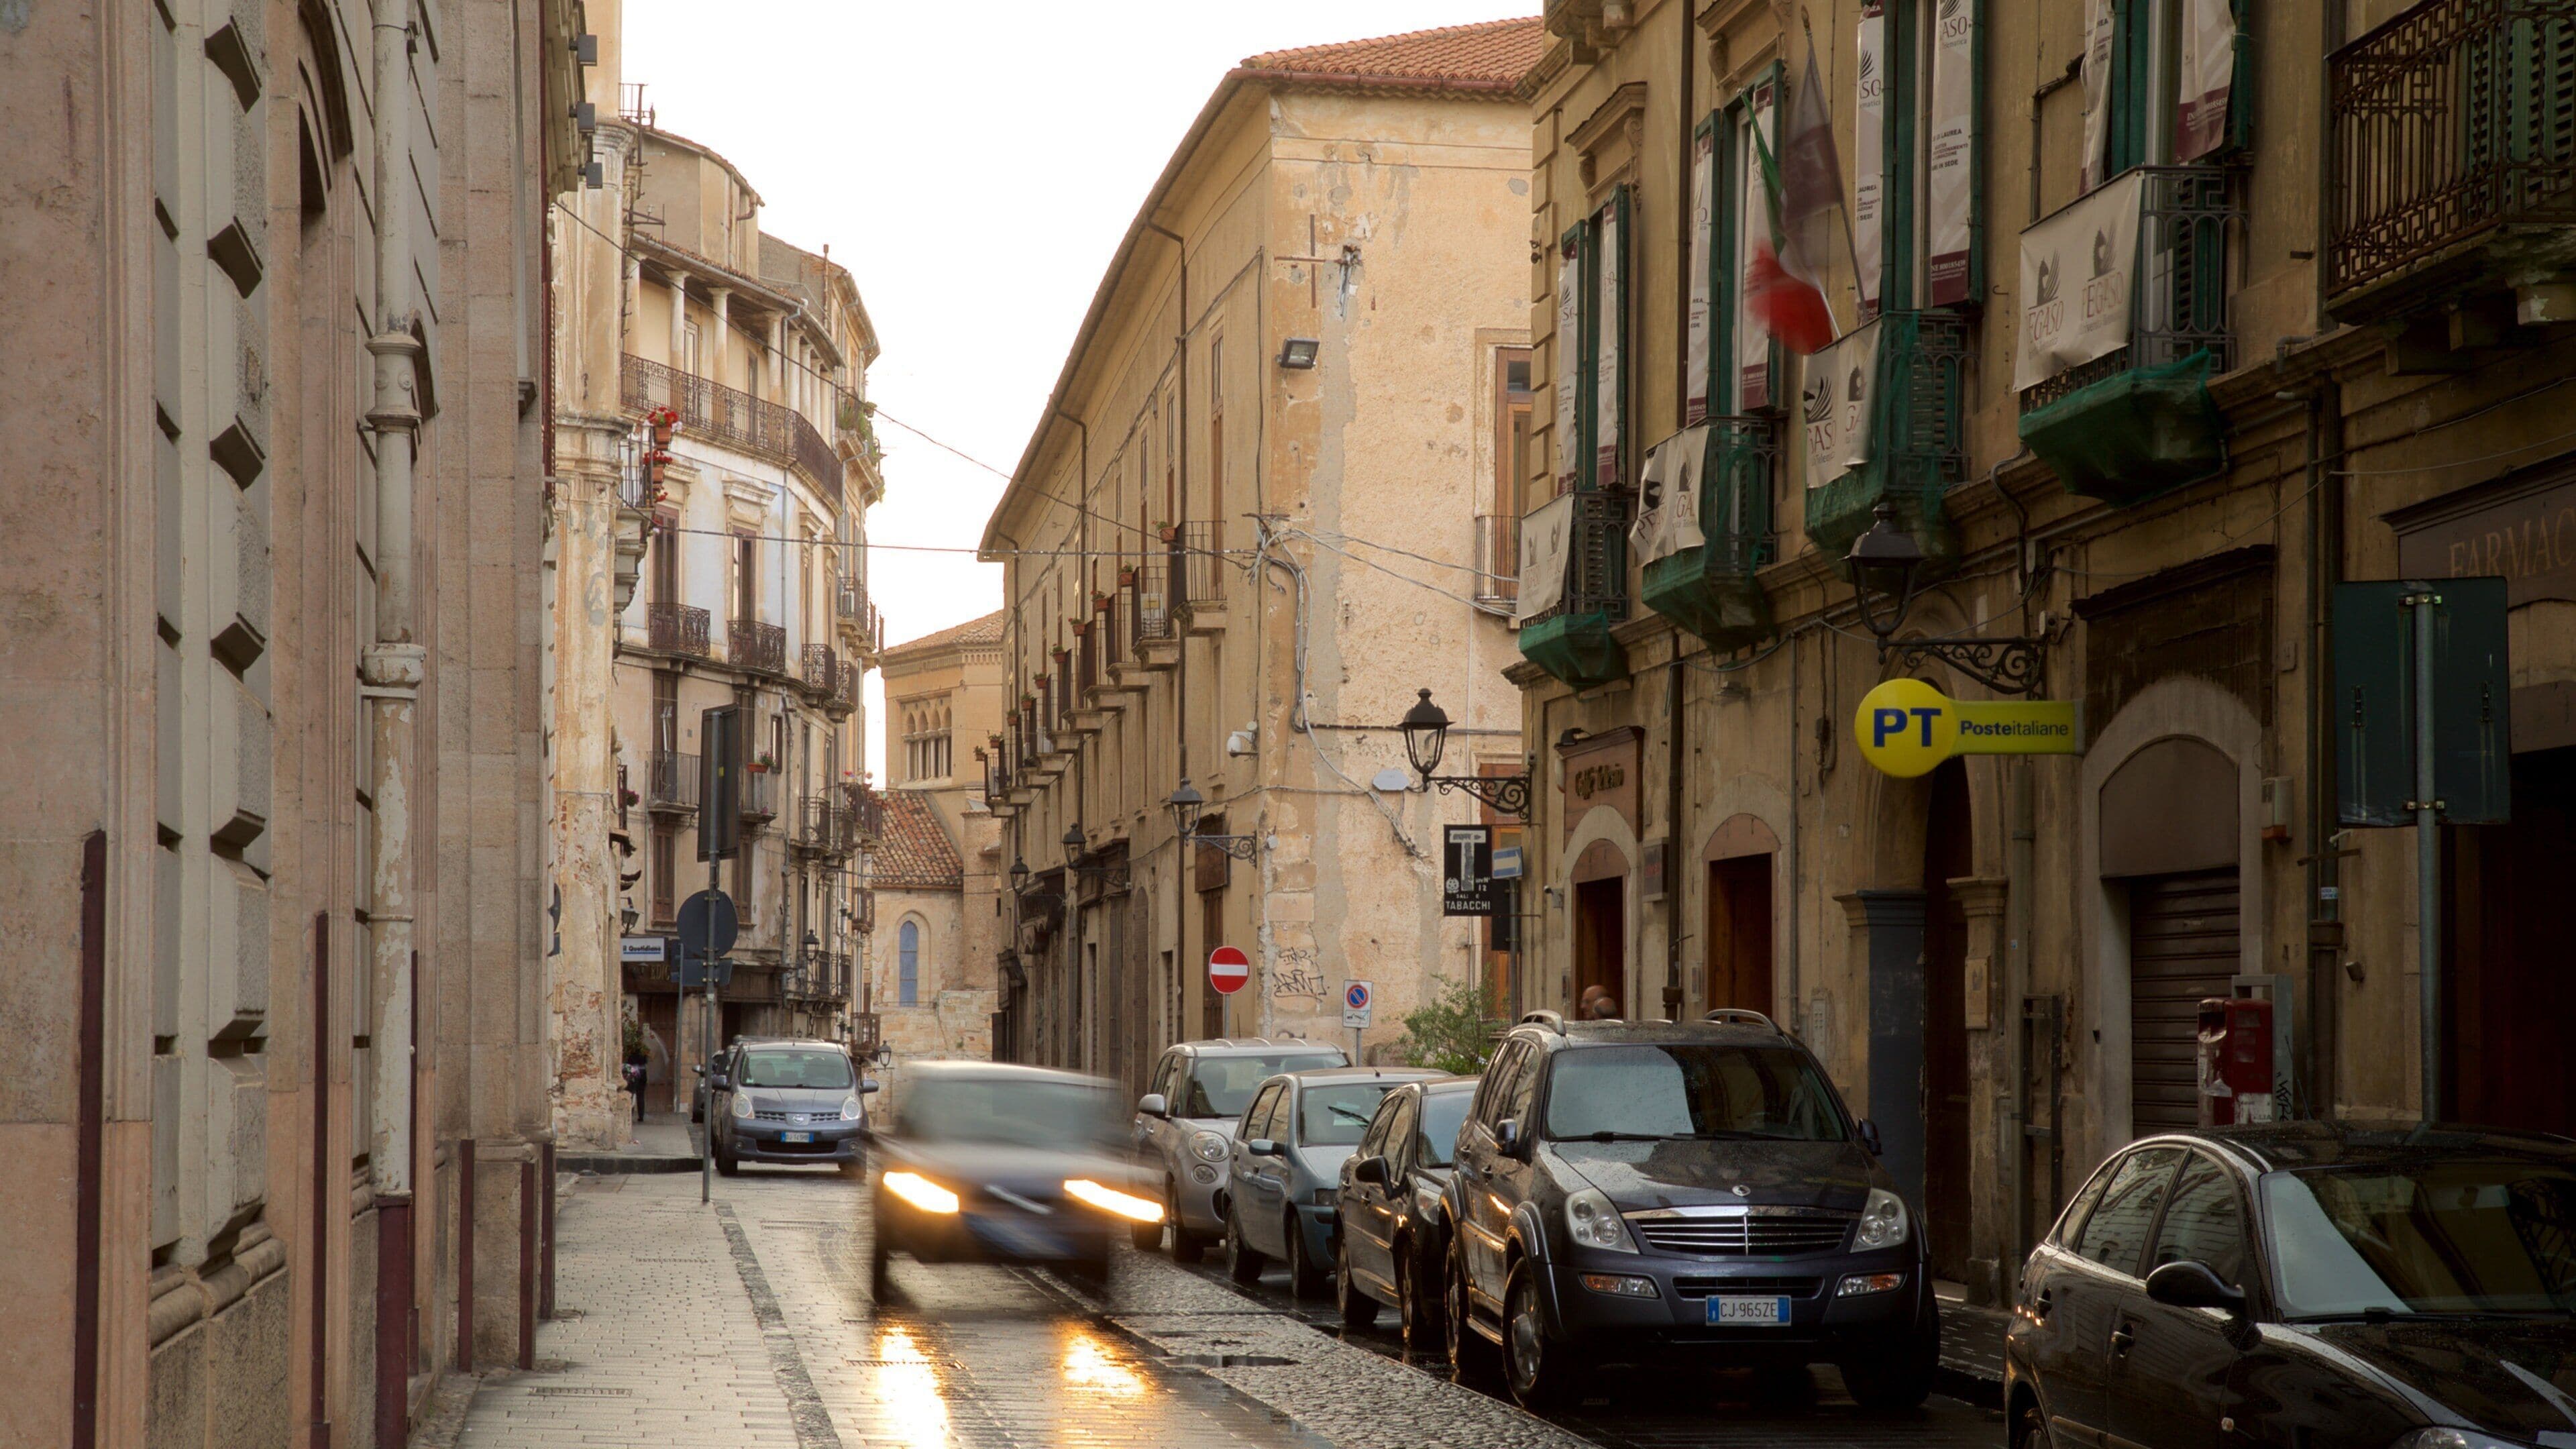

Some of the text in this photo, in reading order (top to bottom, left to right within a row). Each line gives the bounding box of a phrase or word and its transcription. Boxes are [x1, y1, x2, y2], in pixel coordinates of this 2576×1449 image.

[1941, 128, 1962, 139] LAUREA
[2027, 301, 2063, 343] EGASO
[1874, 708, 1942, 748] PT
[1960, 720, 2068, 736] Posteitaliane
[1446, 900, 1491, 910] TABACCHI
